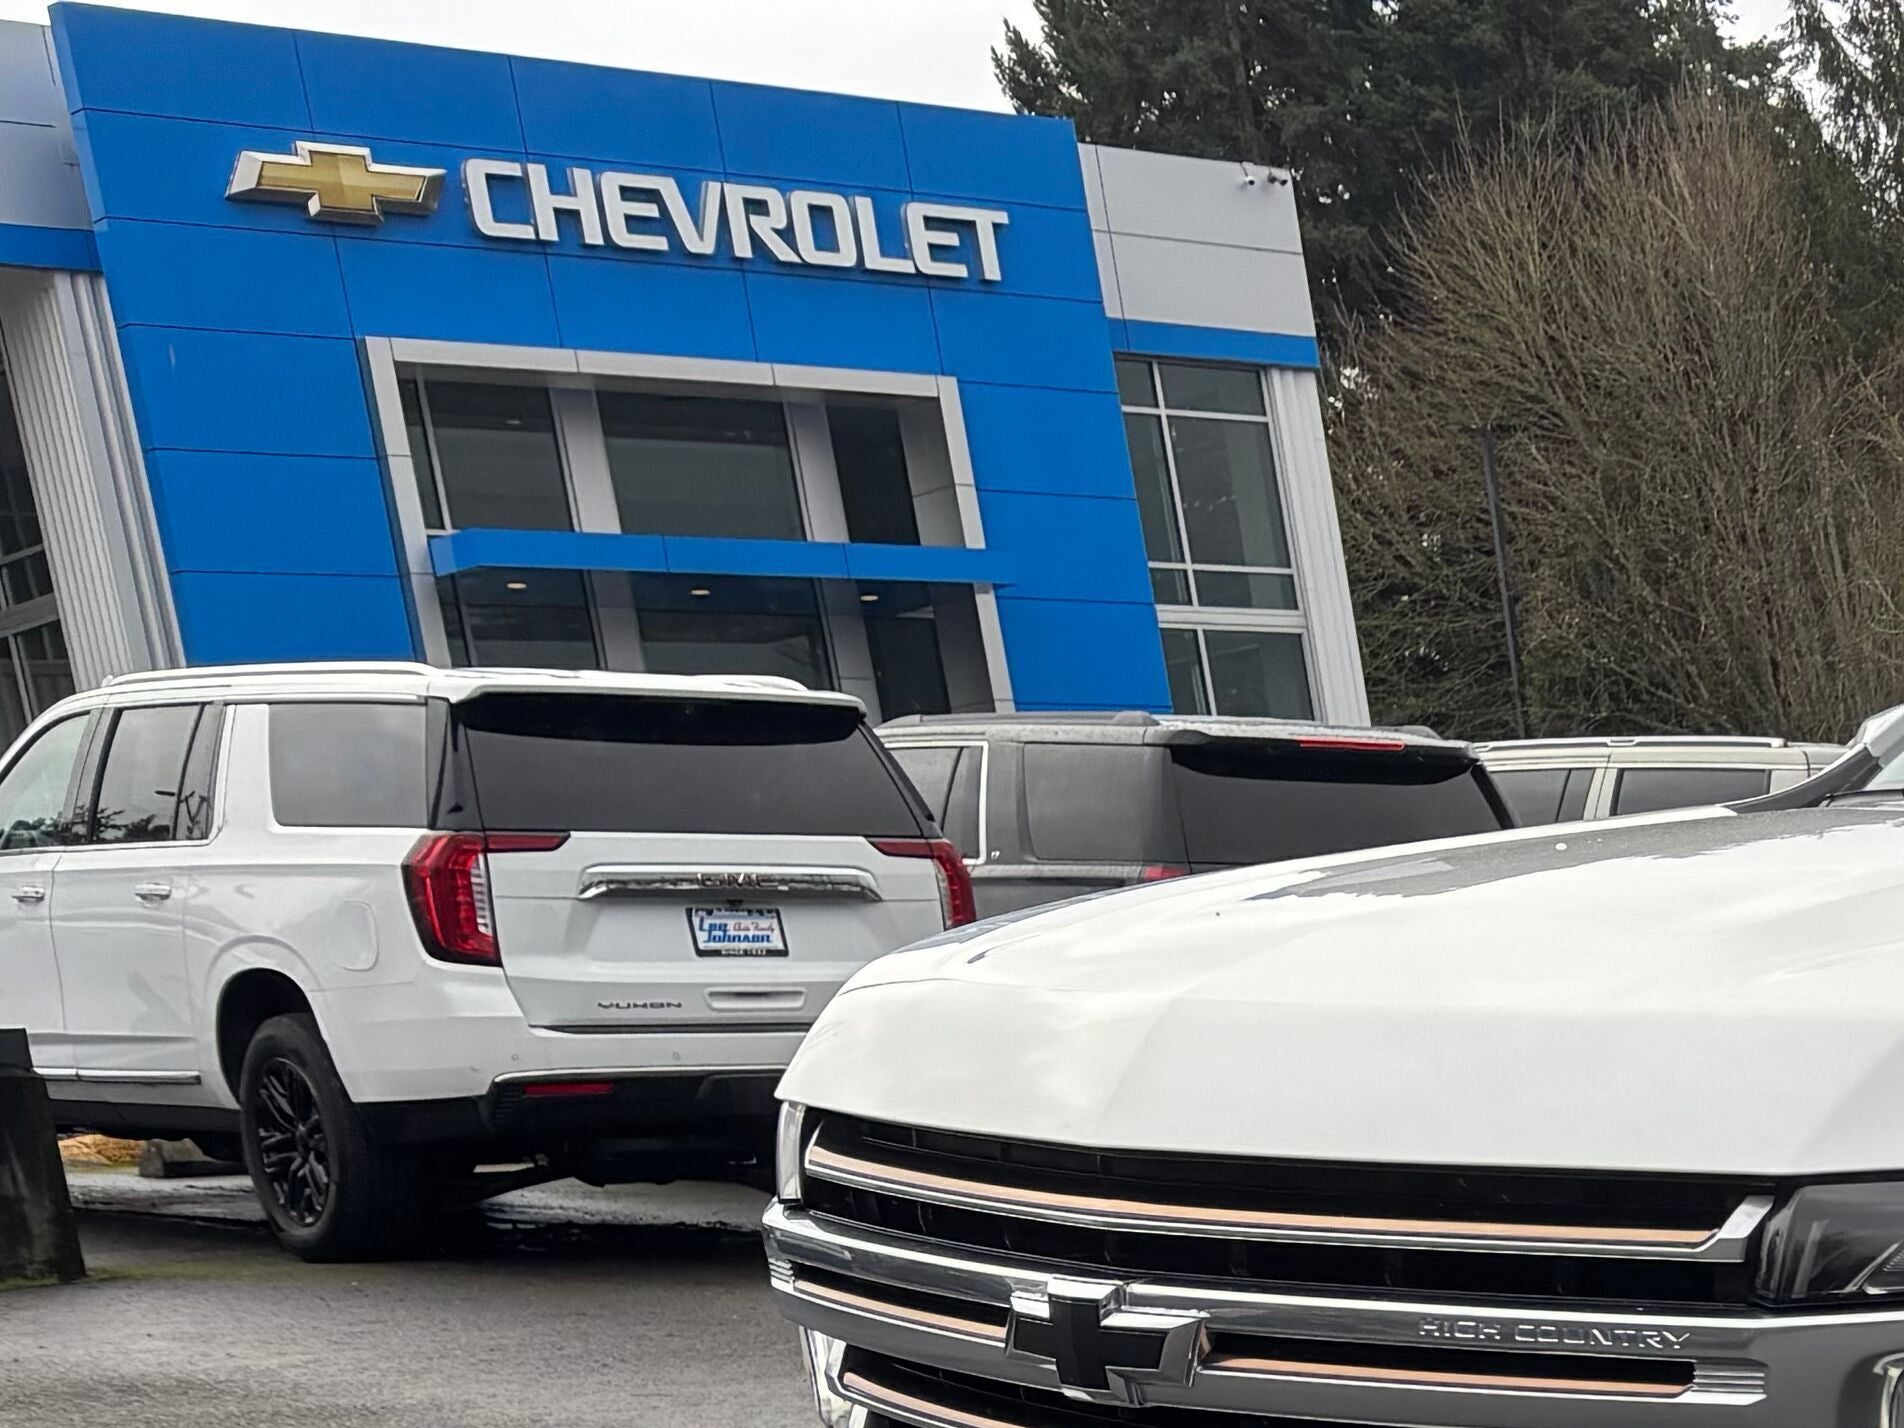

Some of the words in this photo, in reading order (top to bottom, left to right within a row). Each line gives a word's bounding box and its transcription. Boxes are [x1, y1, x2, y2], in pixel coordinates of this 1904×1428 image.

[461, 158, 1010, 282] CHEVROLET
[1418, 1316, 1501, 1341] HIGH
[1514, 1324, 1691, 1350] COUNTRY
